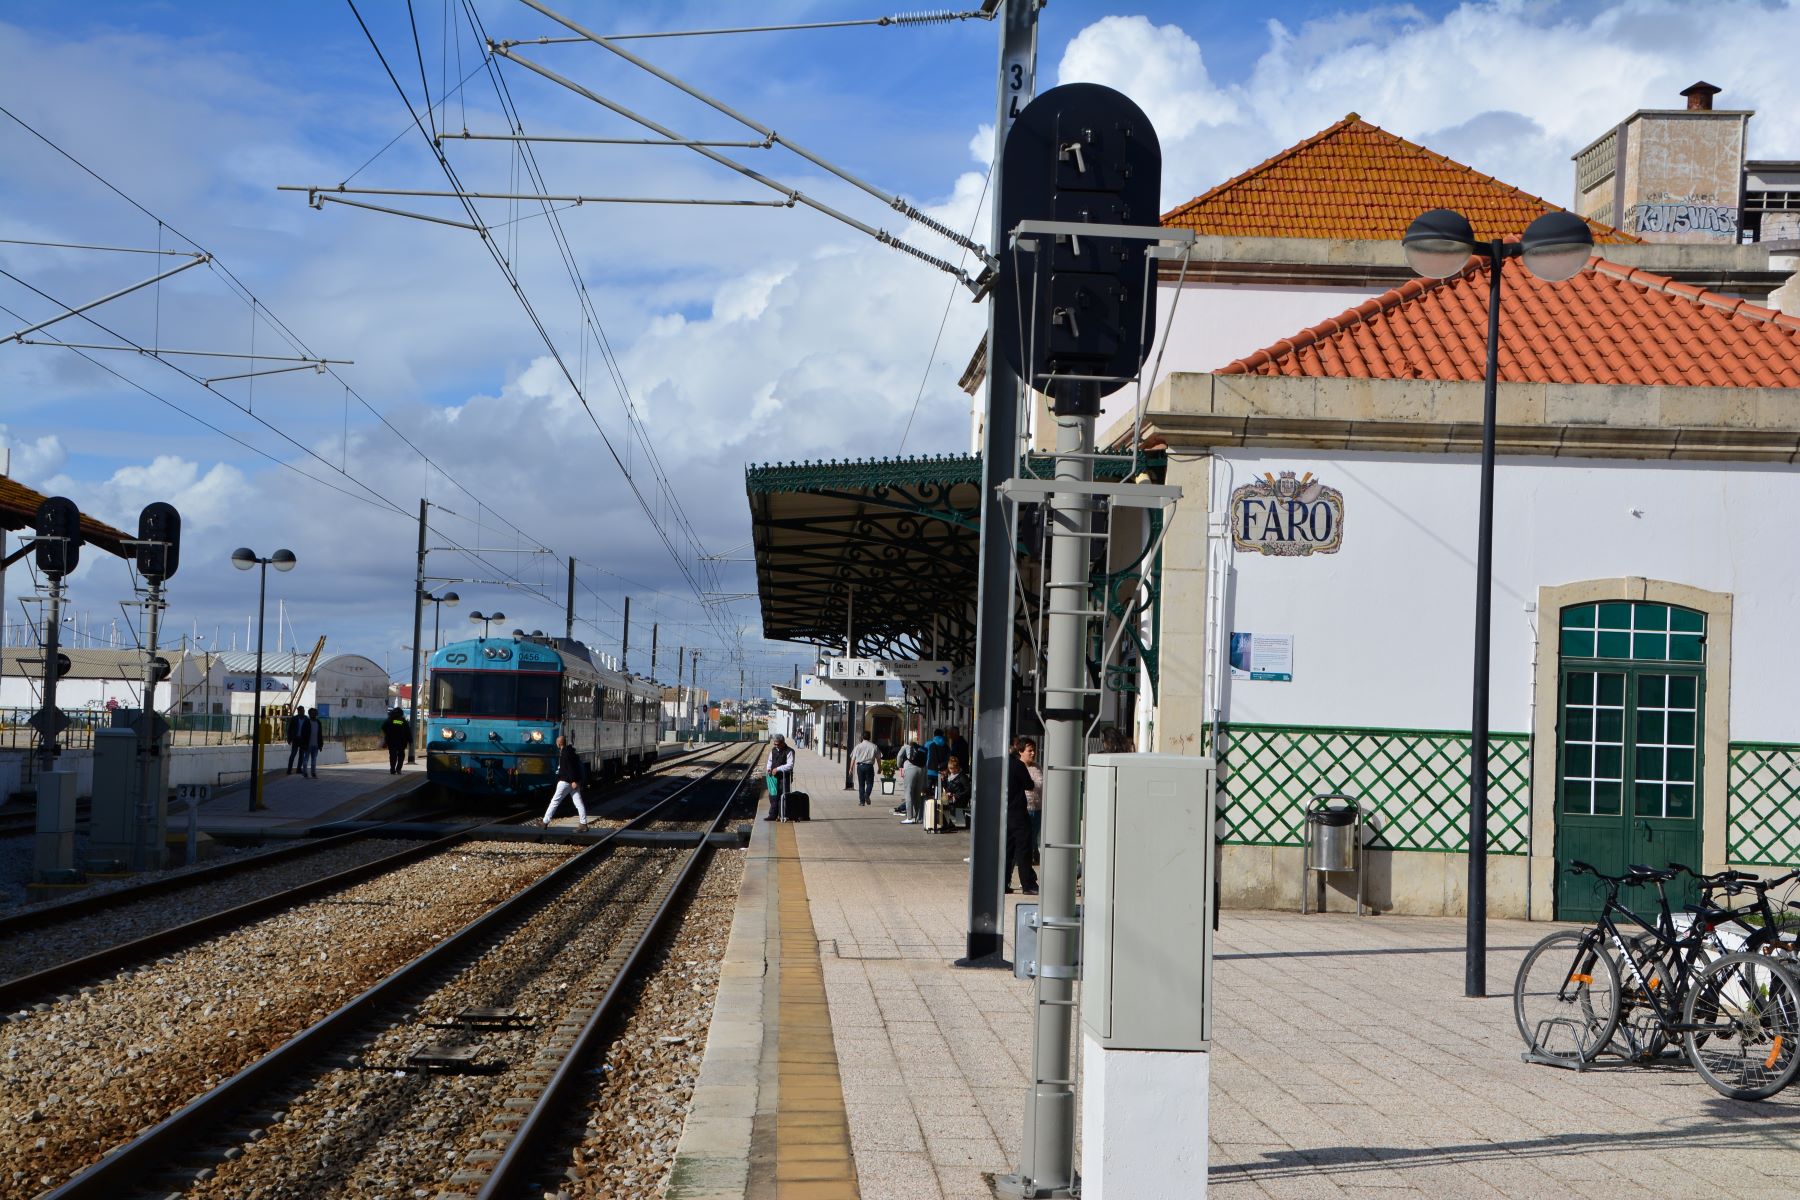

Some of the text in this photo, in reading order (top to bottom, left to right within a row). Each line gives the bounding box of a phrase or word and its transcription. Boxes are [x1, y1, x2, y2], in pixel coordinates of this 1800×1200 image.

[1241, 499, 1333, 541] FARO
[244, 682, 272, 691] 3 2
[180, 785, 207, 798] 340
